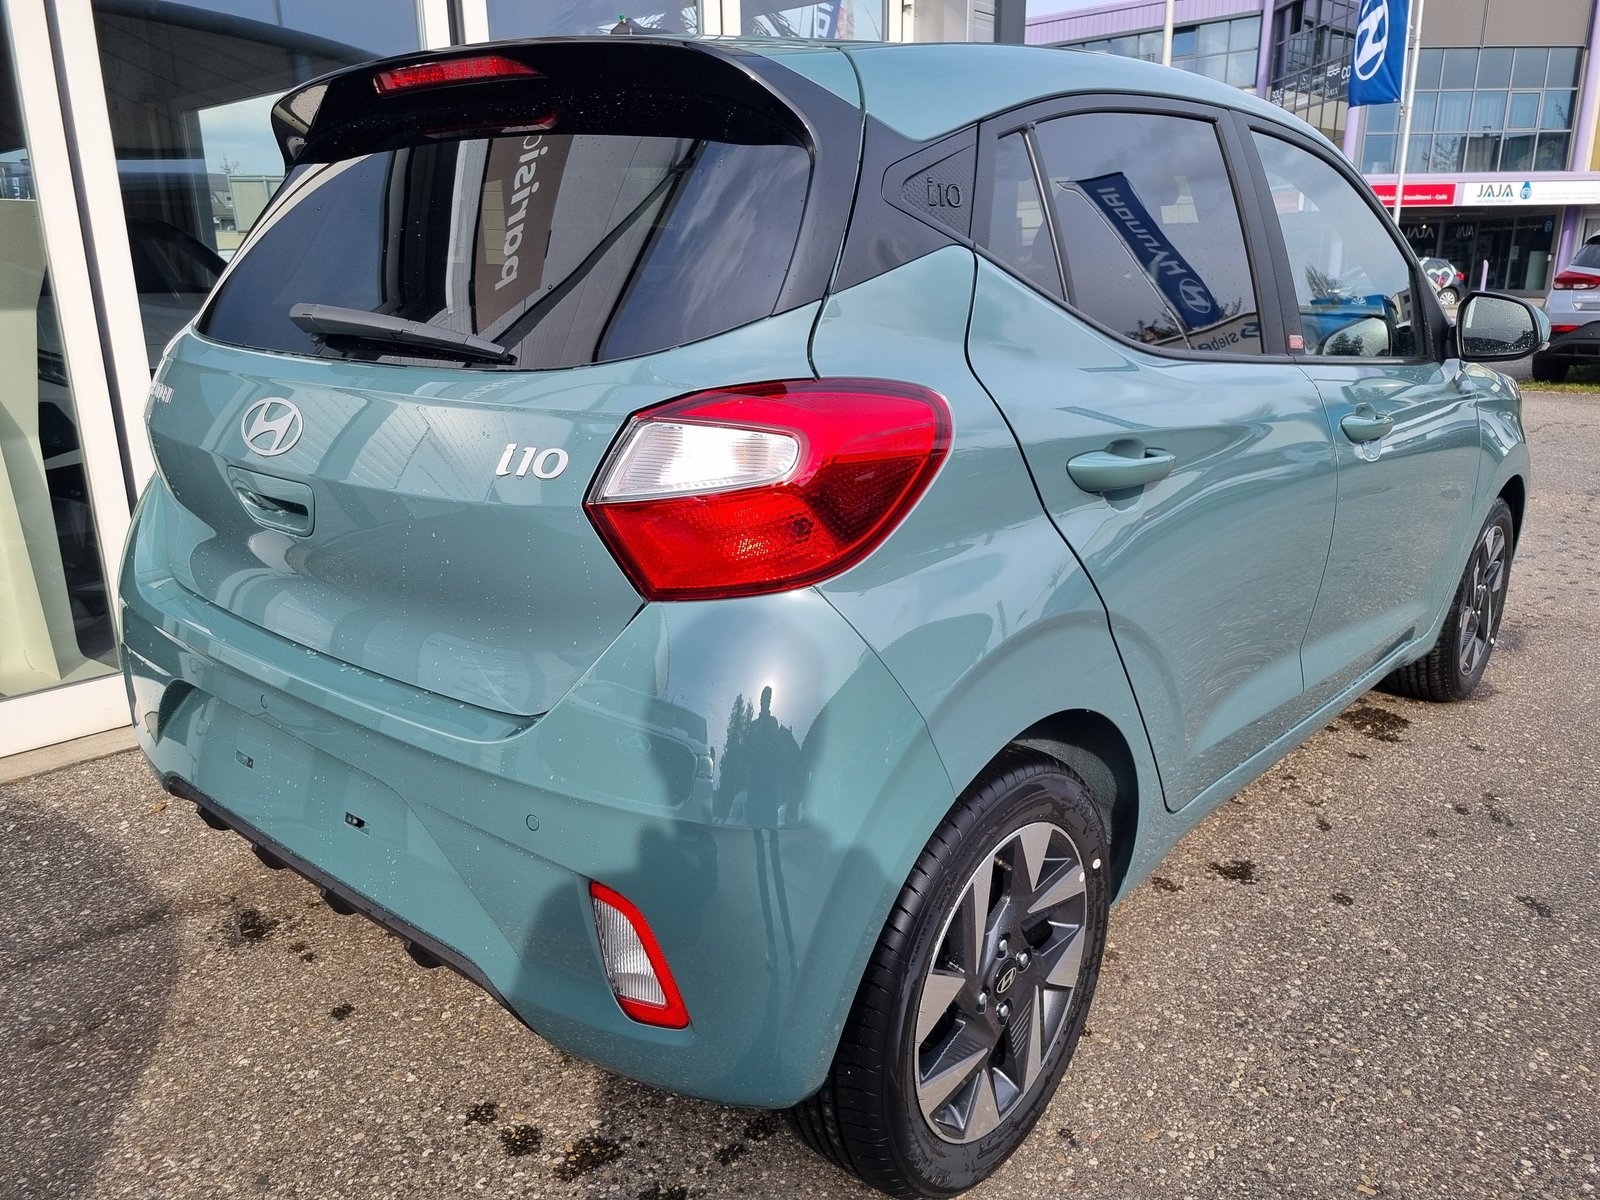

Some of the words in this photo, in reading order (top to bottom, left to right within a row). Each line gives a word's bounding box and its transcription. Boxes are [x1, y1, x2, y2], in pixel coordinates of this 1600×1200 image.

[927, 176, 962, 208] i10
[1477, 184, 1514, 198] JAJA
[495, 442, 569, 479] i10
